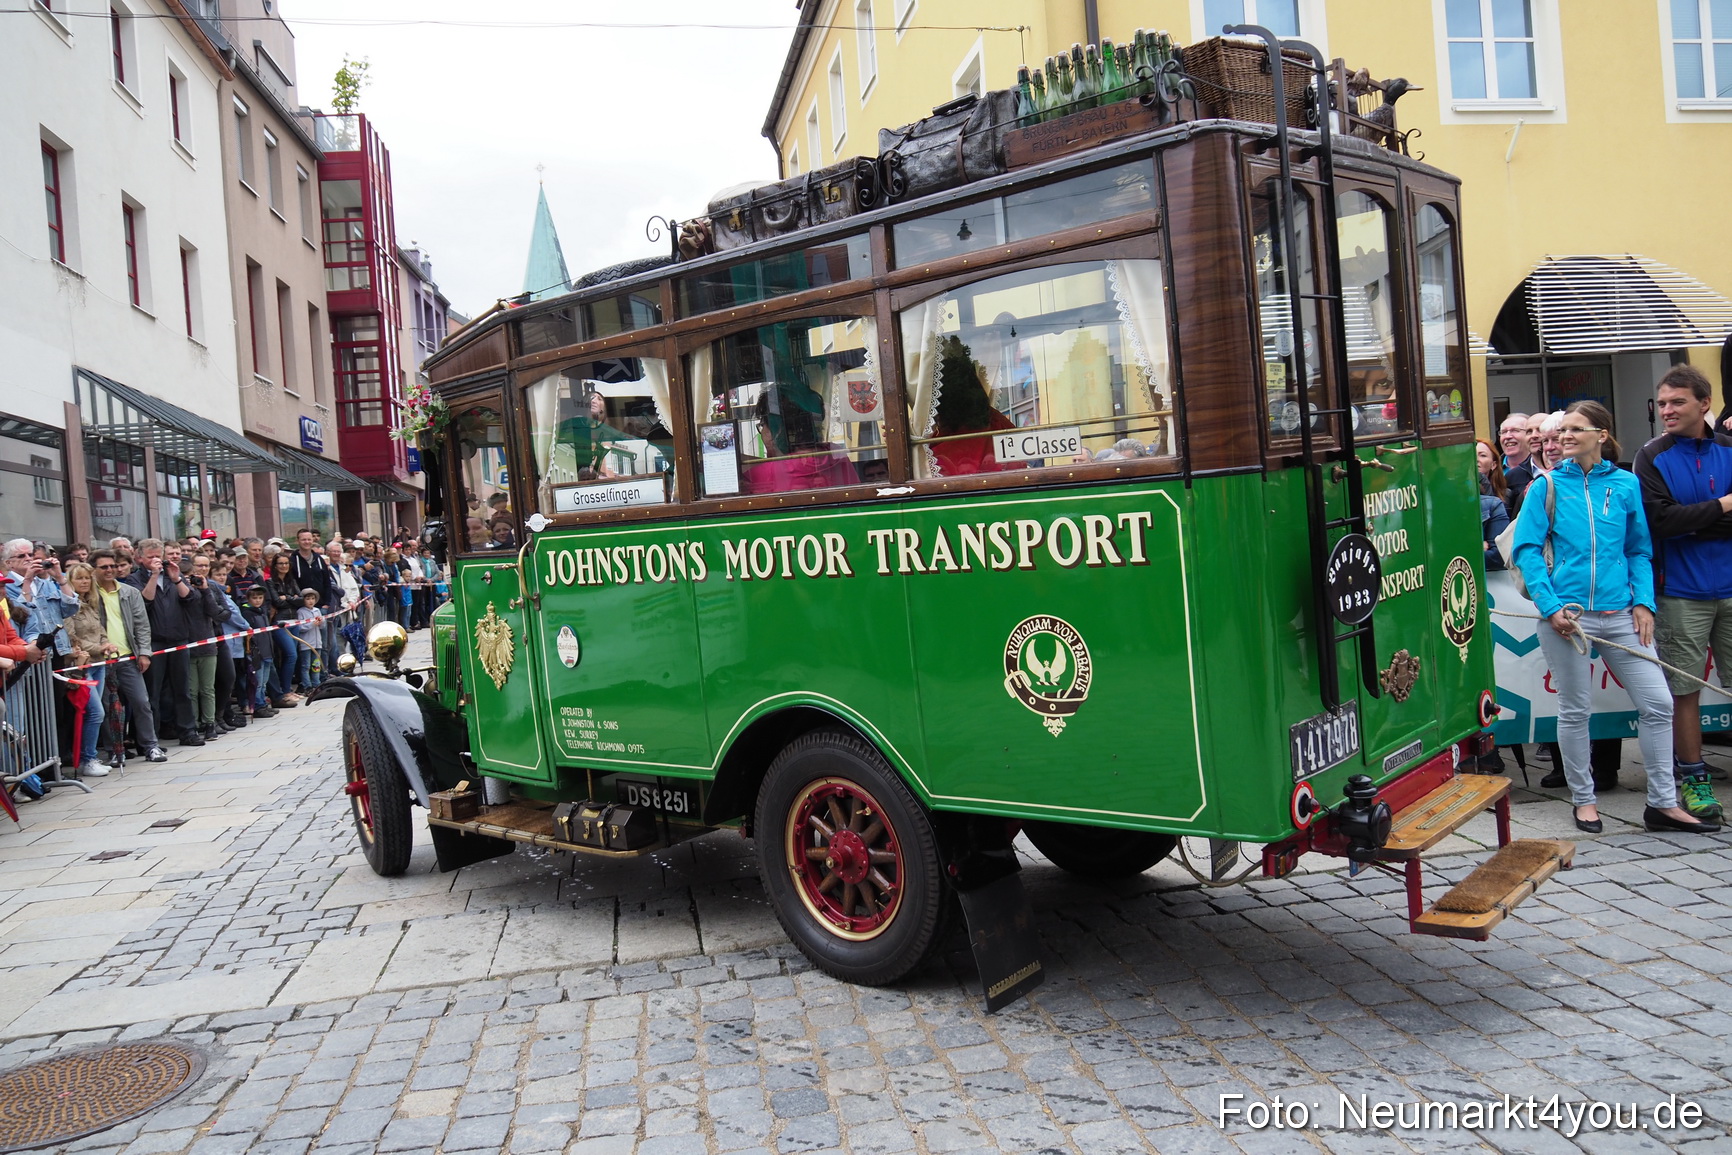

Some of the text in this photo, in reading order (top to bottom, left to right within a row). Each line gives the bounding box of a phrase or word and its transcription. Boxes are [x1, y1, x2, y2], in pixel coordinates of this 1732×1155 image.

[1021, 436, 1077, 456] Classe
[573, 487, 641, 505] Grosselfingen
[1363, 484, 1418, 518] HNSTON'S
[545, 511, 1153, 586] JOHNSTON'S MOTOR TRANSPORT
[1328, 541, 1376, 585] Baujahr
[1379, 564, 1425, 602] NSPORT
[1338, 589, 1370, 612] 1923
[1007, 618, 1051, 659] NUNQUAM
[1053, 621, 1078, 644] NON
[560, 706, 584, 717] OPERATED
[579, 730, 599, 740] SURREY
[603, 720, 619, 730] SONS
[566, 739, 645, 754] TELEPHONE RICHMOND 0975
